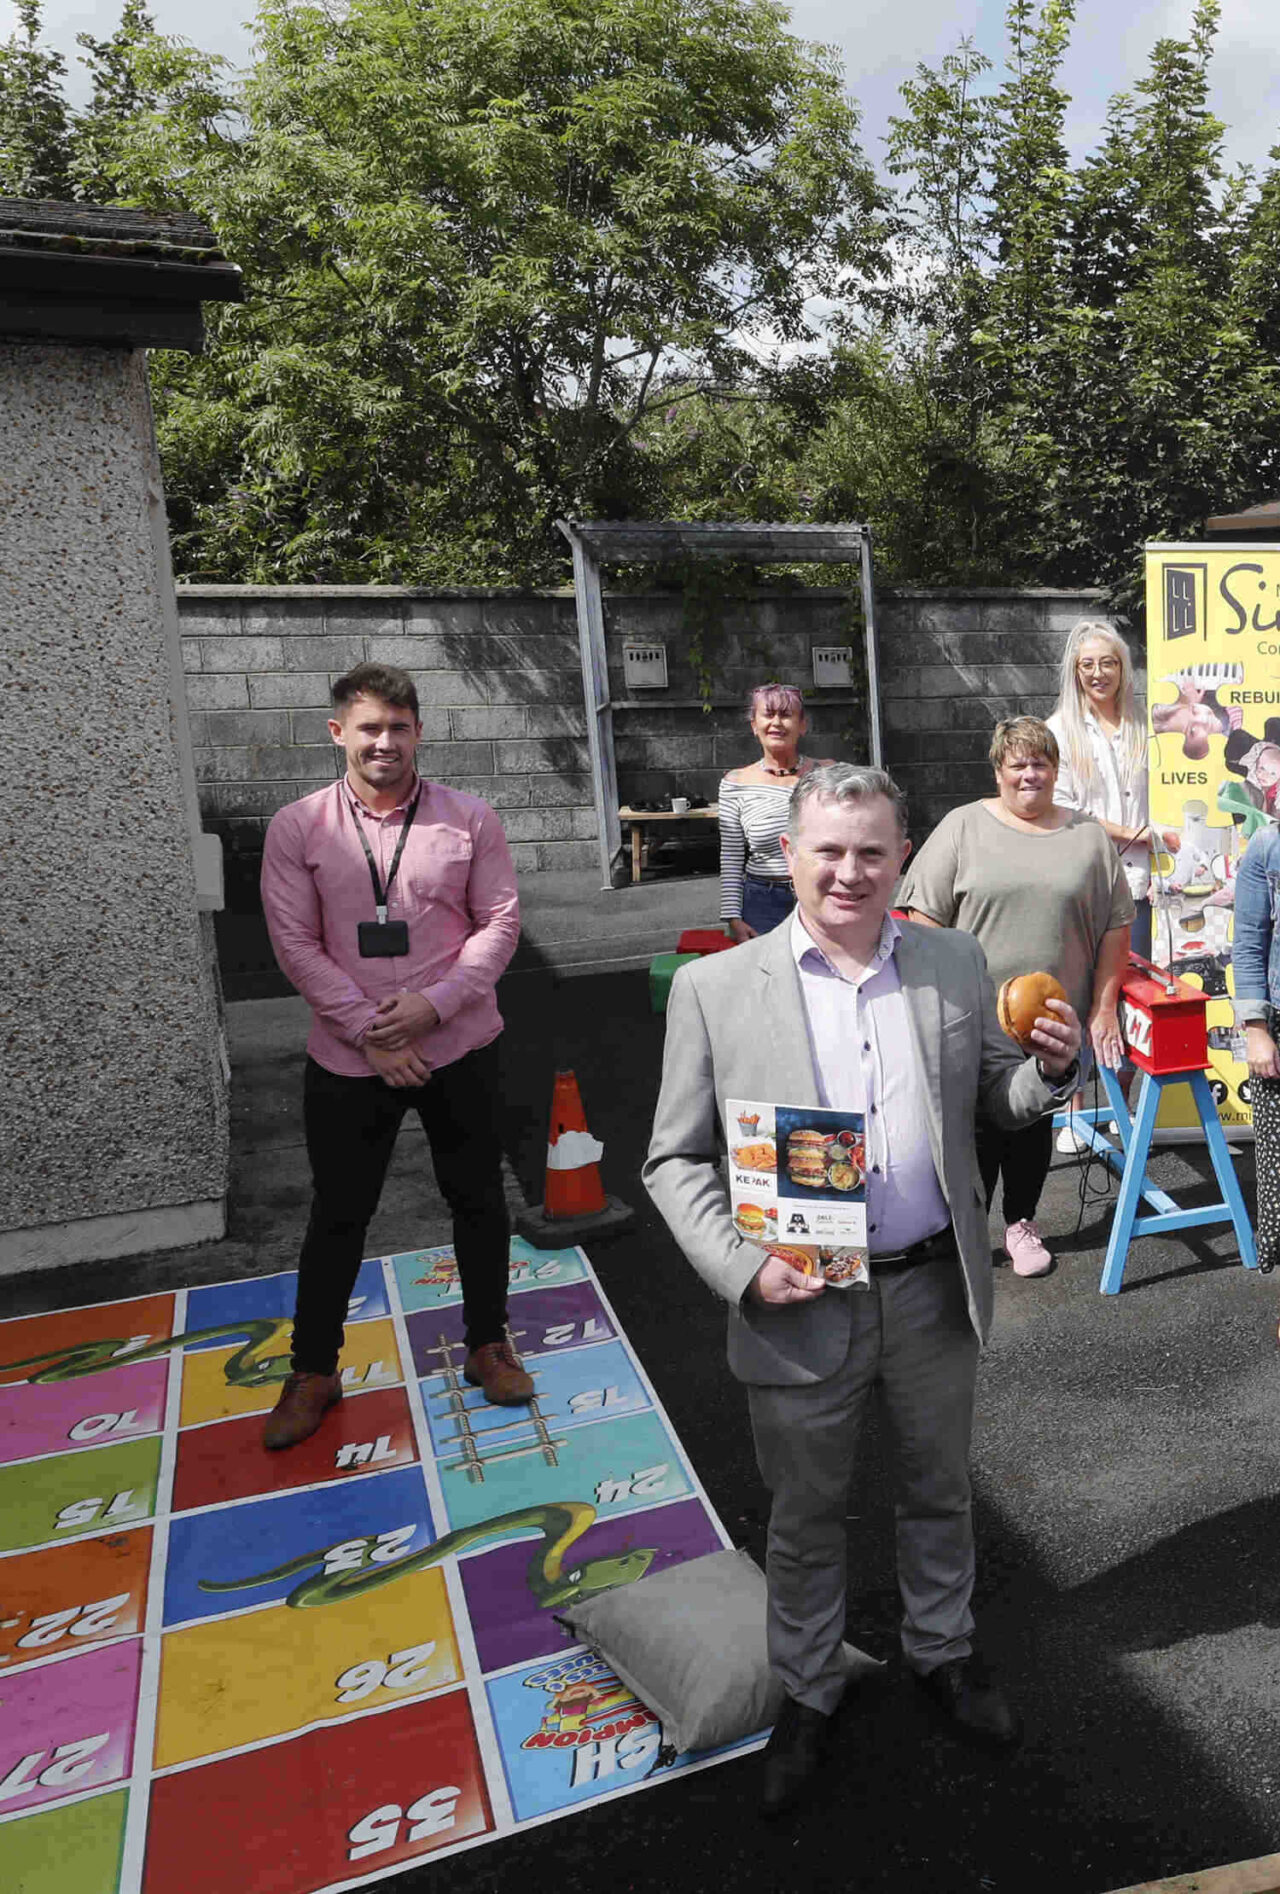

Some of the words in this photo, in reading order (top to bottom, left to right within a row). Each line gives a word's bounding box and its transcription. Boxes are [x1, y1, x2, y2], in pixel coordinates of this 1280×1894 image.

[1161, 772, 1208, 785] LIVES
[542, 1318, 602, 1345] 12
[68, 1408, 138, 1441] 10
[334, 1435, 397, 1468] 14
[594, 1463, 669, 1503] 24
[53, 1488, 136, 1529] 15
[16, 1592, 131, 1648] 22
[335, 1641, 437, 1703] 26
[0, 1732, 110, 1800] 27
[346, 1785, 462, 1861] 35
